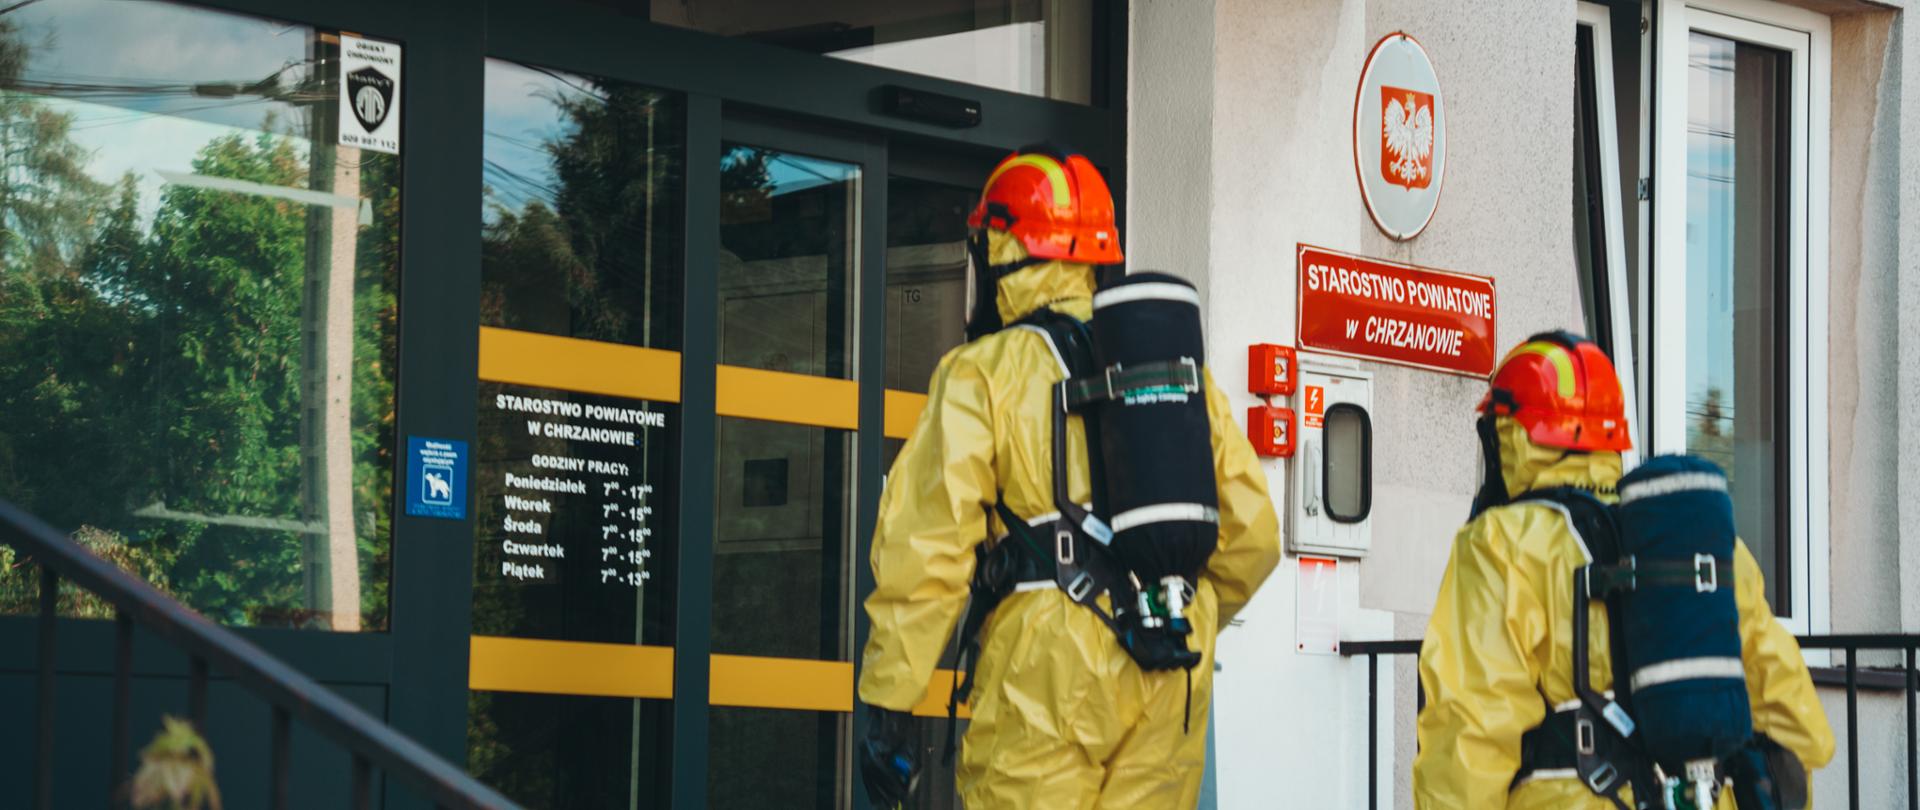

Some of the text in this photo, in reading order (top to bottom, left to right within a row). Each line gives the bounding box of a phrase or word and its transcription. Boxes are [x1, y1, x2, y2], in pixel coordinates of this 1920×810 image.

[904, 289, 921, 303] TG
[1308, 264, 1491, 319] STAROSTWO POWIATOWE
[1365, 315, 1464, 357] CHRZANOWIE
[496, 394, 665, 427] STAROSTWO POWIATOWE
[527, 420, 635, 446] W CHRZANOWIE
[532, 454, 629, 476] GODZINY PRACY:
[505, 473, 586, 494] Poniedziałek
[504, 495, 551, 513] Wtorek
[503, 515, 542, 534] Środa
[503, 540, 564, 558] Czwartek
[502, 561, 544, 581] Piątek
